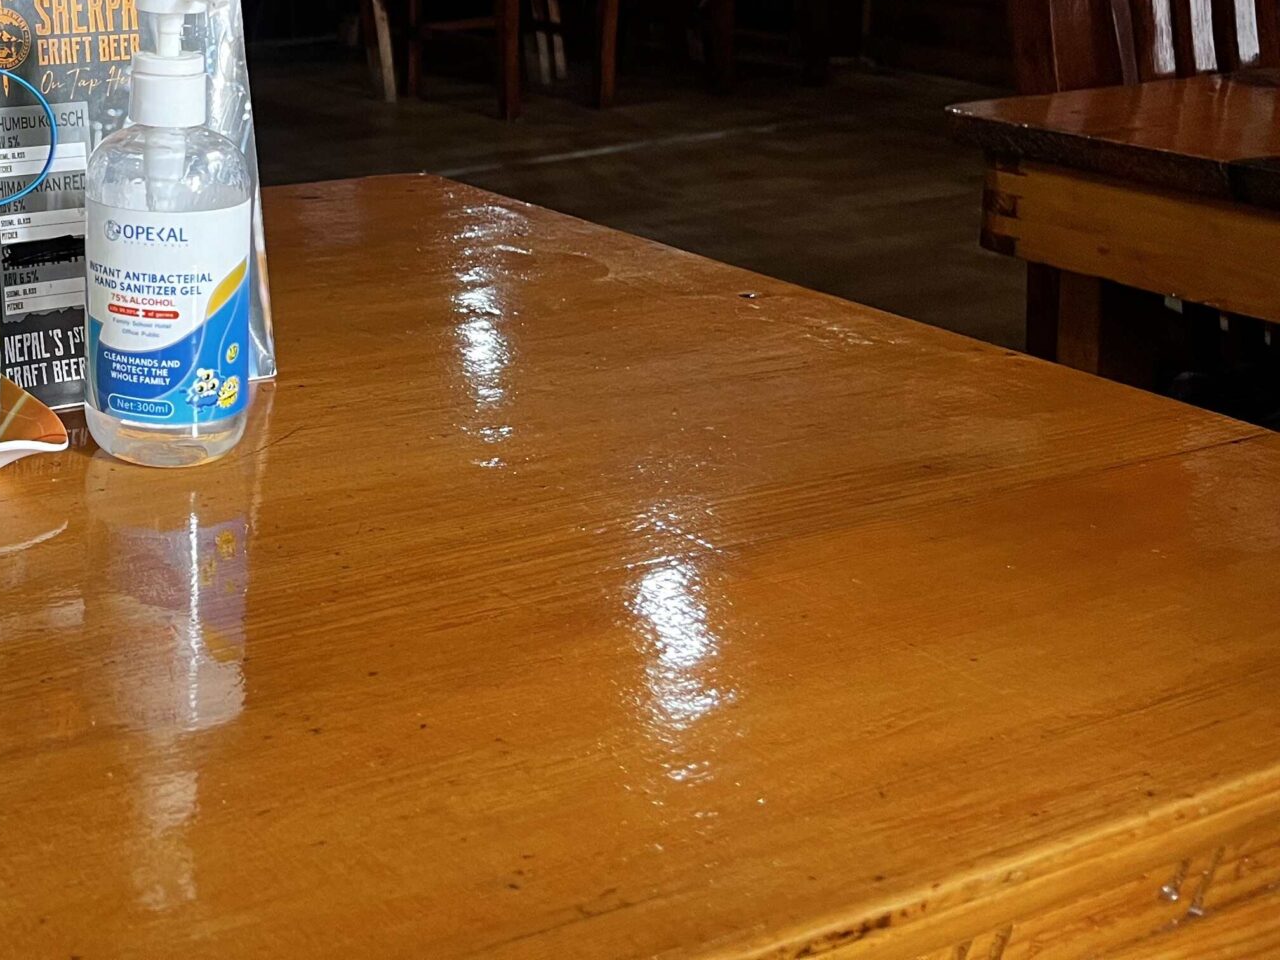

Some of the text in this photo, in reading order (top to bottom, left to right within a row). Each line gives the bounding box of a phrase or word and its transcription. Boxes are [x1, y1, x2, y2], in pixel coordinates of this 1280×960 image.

[38, 33, 140, 66] CRAFT BEER
[40, 70, 65, 95] On
[66, 66, 103, 100] Tap
[7, 134, 20, 147] 5%
[13, 200, 26, 212] 5%
[19, 269, 39, 285] 6.5%
[90, 260, 212, 284] INSTANT ANTIBACTERIAL
[94, 275, 202, 296] HAND SANITIZER GEL
[110, 292, 176, 307] 75% ALCOHOL
[4, 325, 85, 364] NEPAL'S 1ST
[103, 350, 180, 368] CLEAN HANDS AND
[5, 357, 85, 388] CRAFT BEER
[110, 370, 170, 386] WHOLE FAMILY
[112, 362, 169, 377] PROTECT THE
[116, 398, 169, 414] Net:300ml
